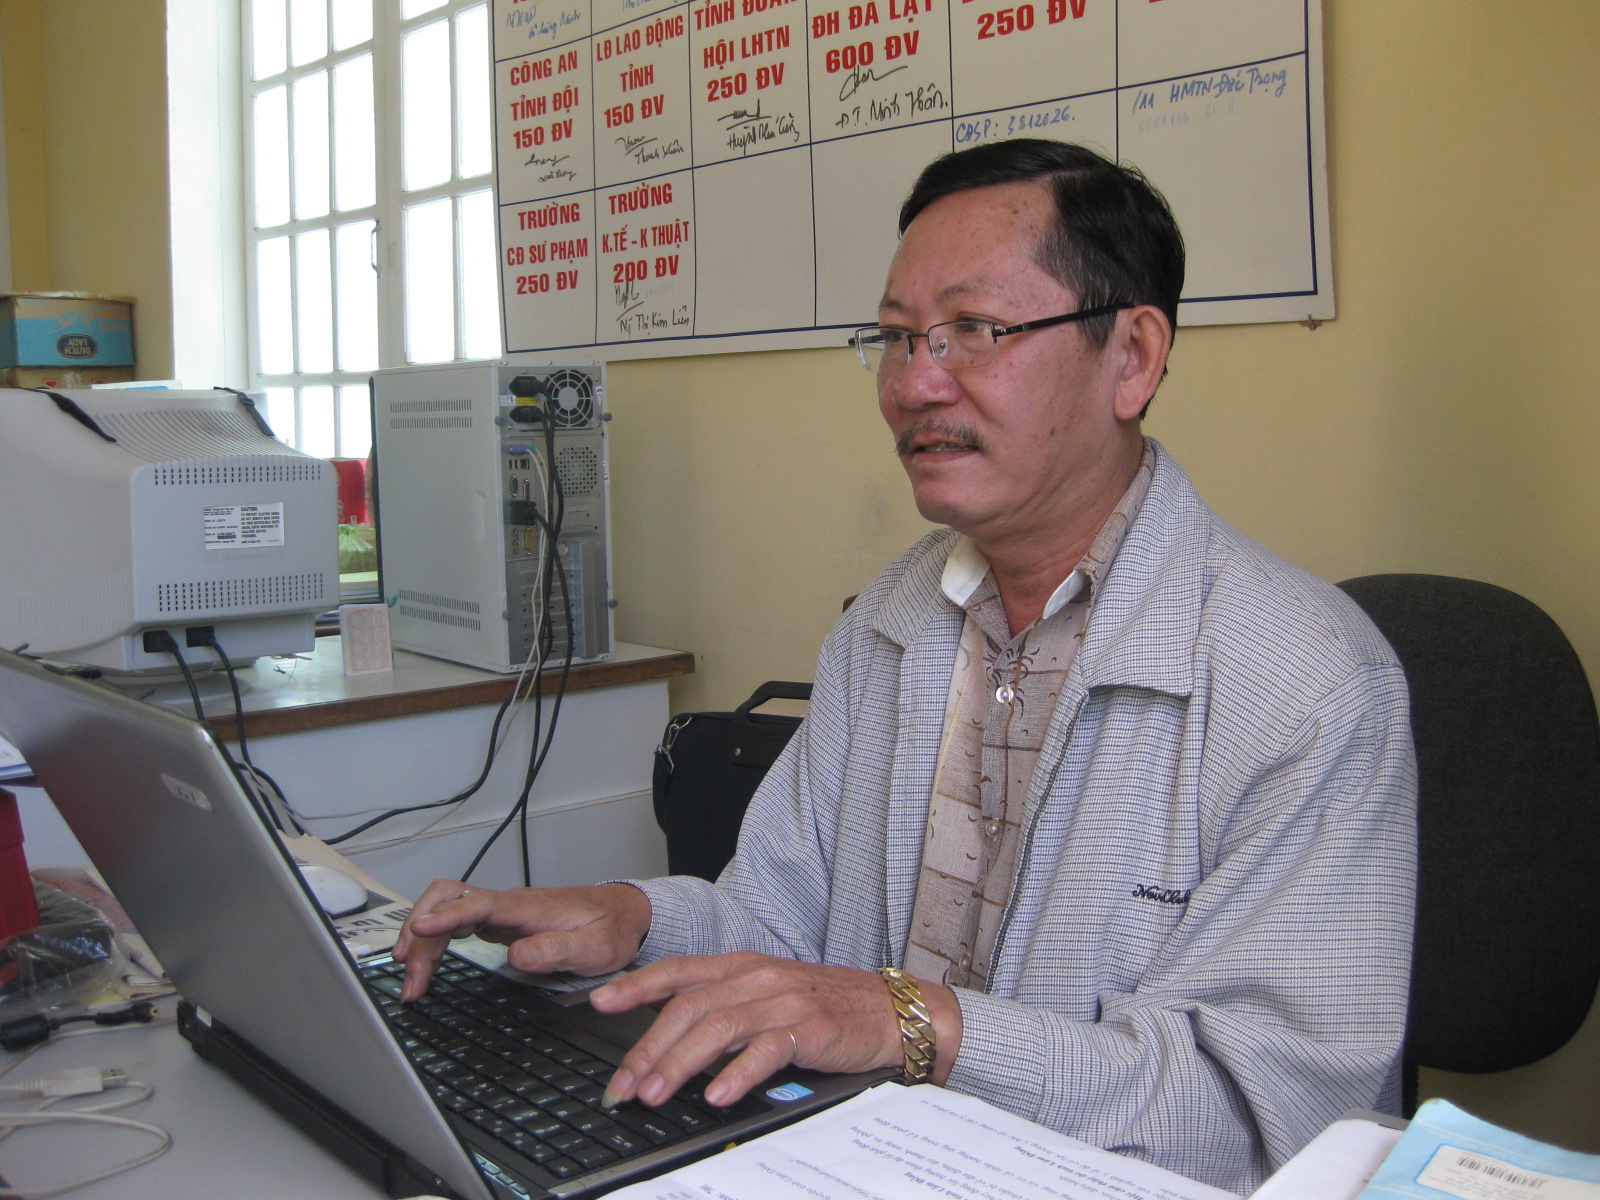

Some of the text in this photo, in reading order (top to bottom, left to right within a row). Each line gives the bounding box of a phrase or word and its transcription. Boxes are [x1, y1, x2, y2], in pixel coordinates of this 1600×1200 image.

[694, 0, 796, 30] TỈNH ĐO
[812, 11, 840, 39] ĐH
[977, 0, 1086, 40] 250 ĐV
[596, 16, 684, 61] LĐ LAO ĐỘNG
[703, 25, 790, 70] HỘI LHTN
[825, 30, 921, 74] 600 ĐV
[511, 51, 578, 85] CÔNG AN
[620, 64, 654, 92] TỈNH
[707, 62, 785, 102] 250 ĐV
[511, 86, 579, 120] TỈNH ĐỘI
[604, 95, 665, 128] 150 ĐV
[513, 119, 573, 149] 150 ĐV
[608, 184, 673, 214] TRƯỜNG
[518, 203, 581, 230] TRƯỜNG
[651, 219, 690, 248] THUẬT
[507, 238, 588, 266] CĐ SƯ PHẠM
[516, 270, 579, 294] 250 ĐV
[613, 255, 679, 283] 200 ĐV
